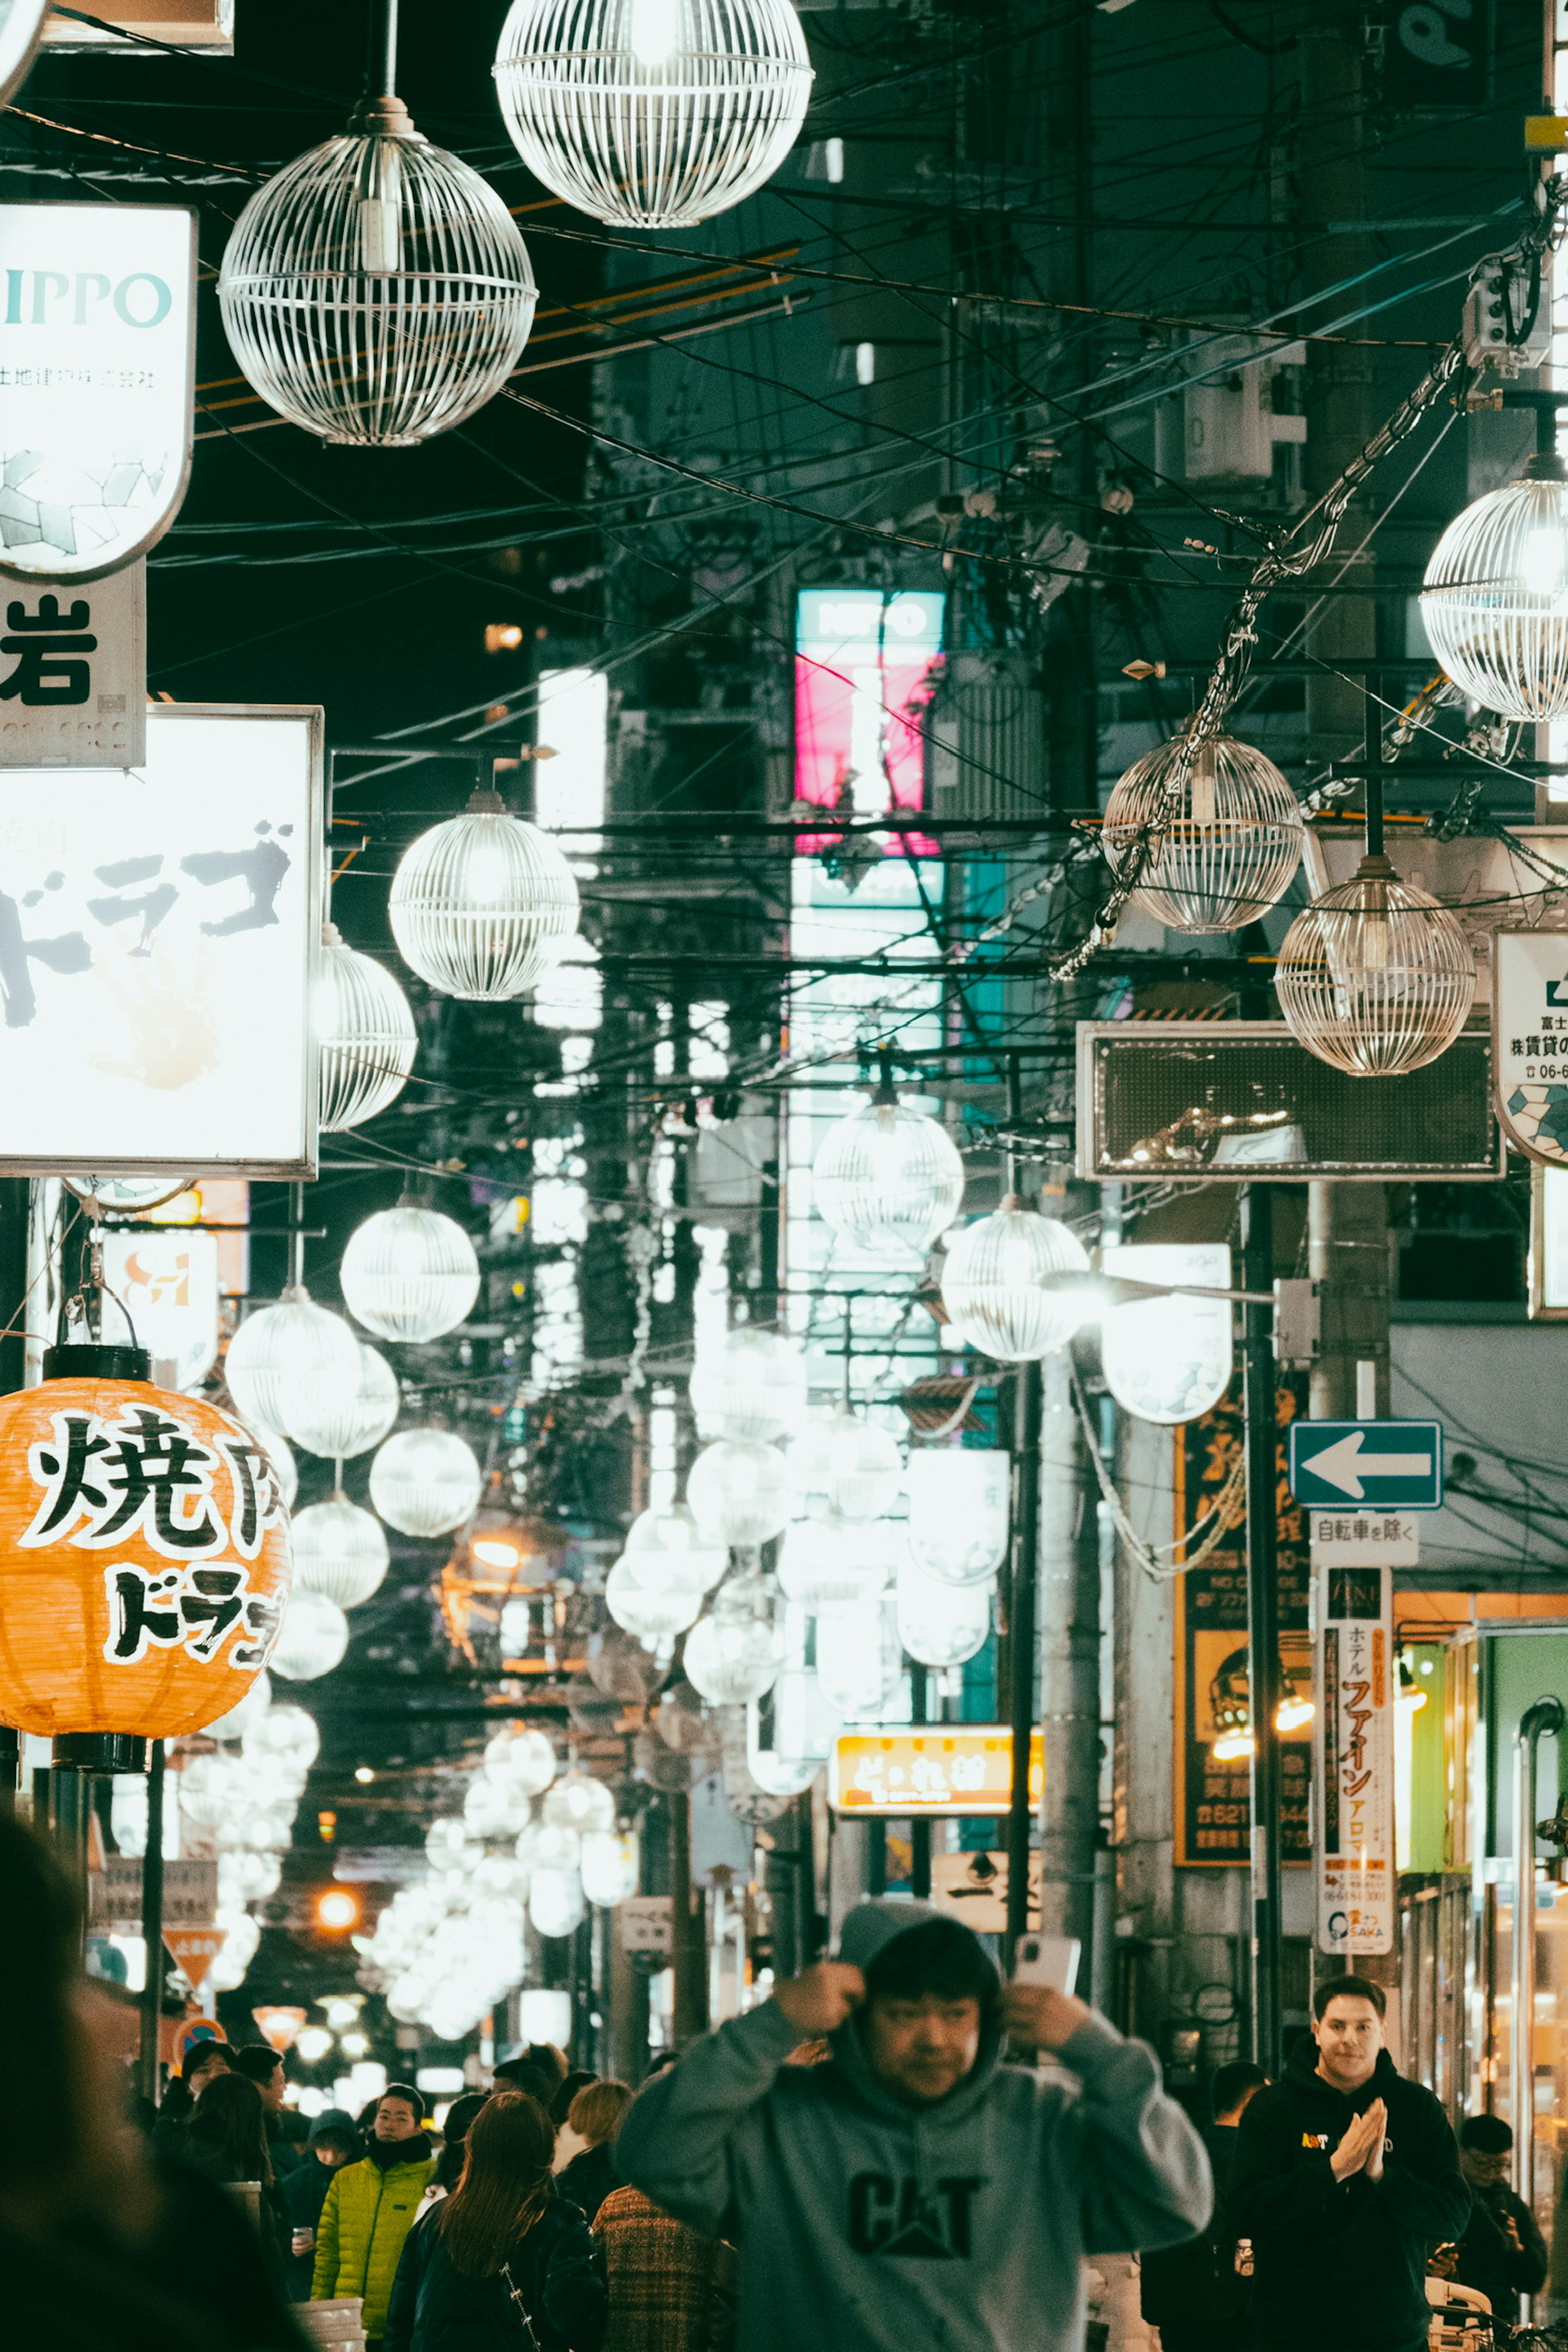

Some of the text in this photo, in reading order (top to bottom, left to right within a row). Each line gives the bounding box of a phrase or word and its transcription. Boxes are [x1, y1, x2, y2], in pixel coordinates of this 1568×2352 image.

[4, 269, 172, 329] IPPO
[0, 593, 98, 706] 岩
[0, 818, 294, 1029] ドラゴ
[1541, 1016, 1568, 1030] 富士
[29, 1406, 290, 1554] 焼肉
[1319, 1519, 1413, 1541] 自転車を除く
[1339, 1681, 1372, 1797] ファイン
[848, 2172, 987, 2259] CAT
